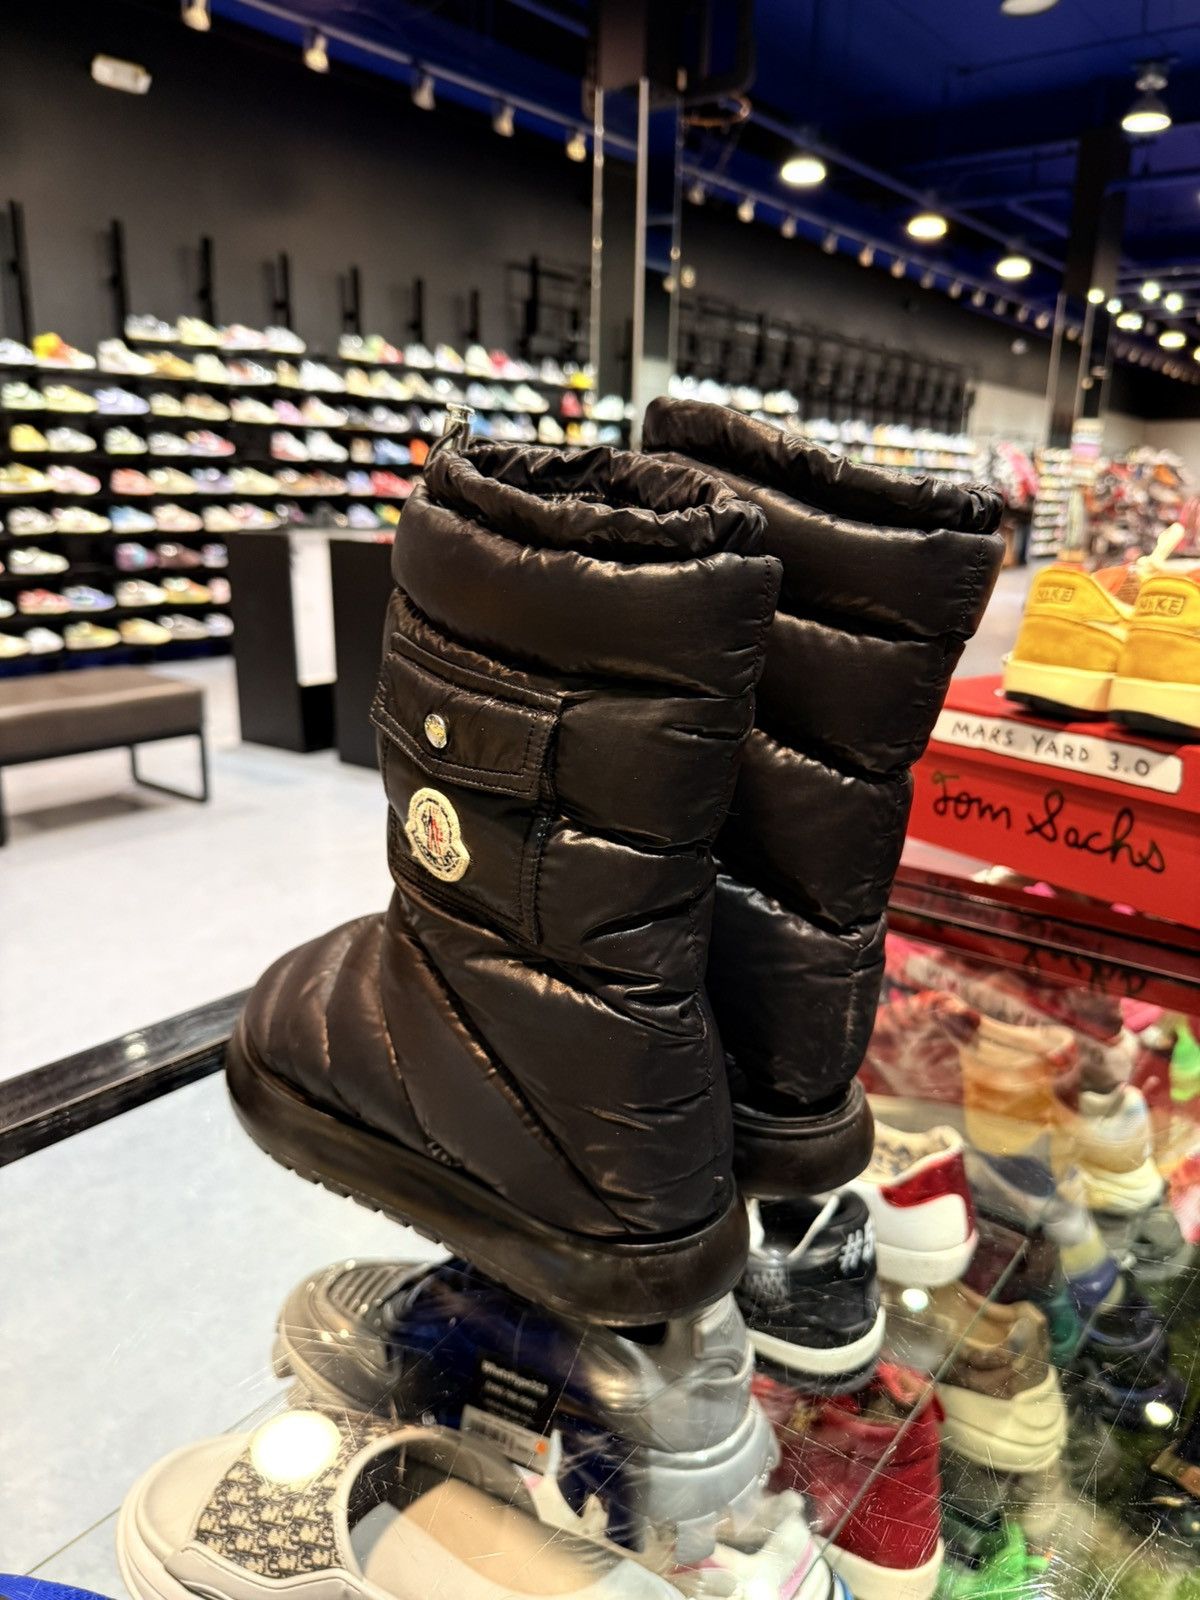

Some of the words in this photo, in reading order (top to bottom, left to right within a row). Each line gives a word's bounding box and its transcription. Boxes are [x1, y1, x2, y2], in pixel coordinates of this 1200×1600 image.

[1137, 597, 1182, 615] NIKE
[952, 721, 1013, 746] MARS
[1032, 735, 1089, 763] YARD
[1108, 753, 1150, 777] 3.0
[932, 772, 1011, 829] Tom
[1025, 790, 1166, 873] Sachs
